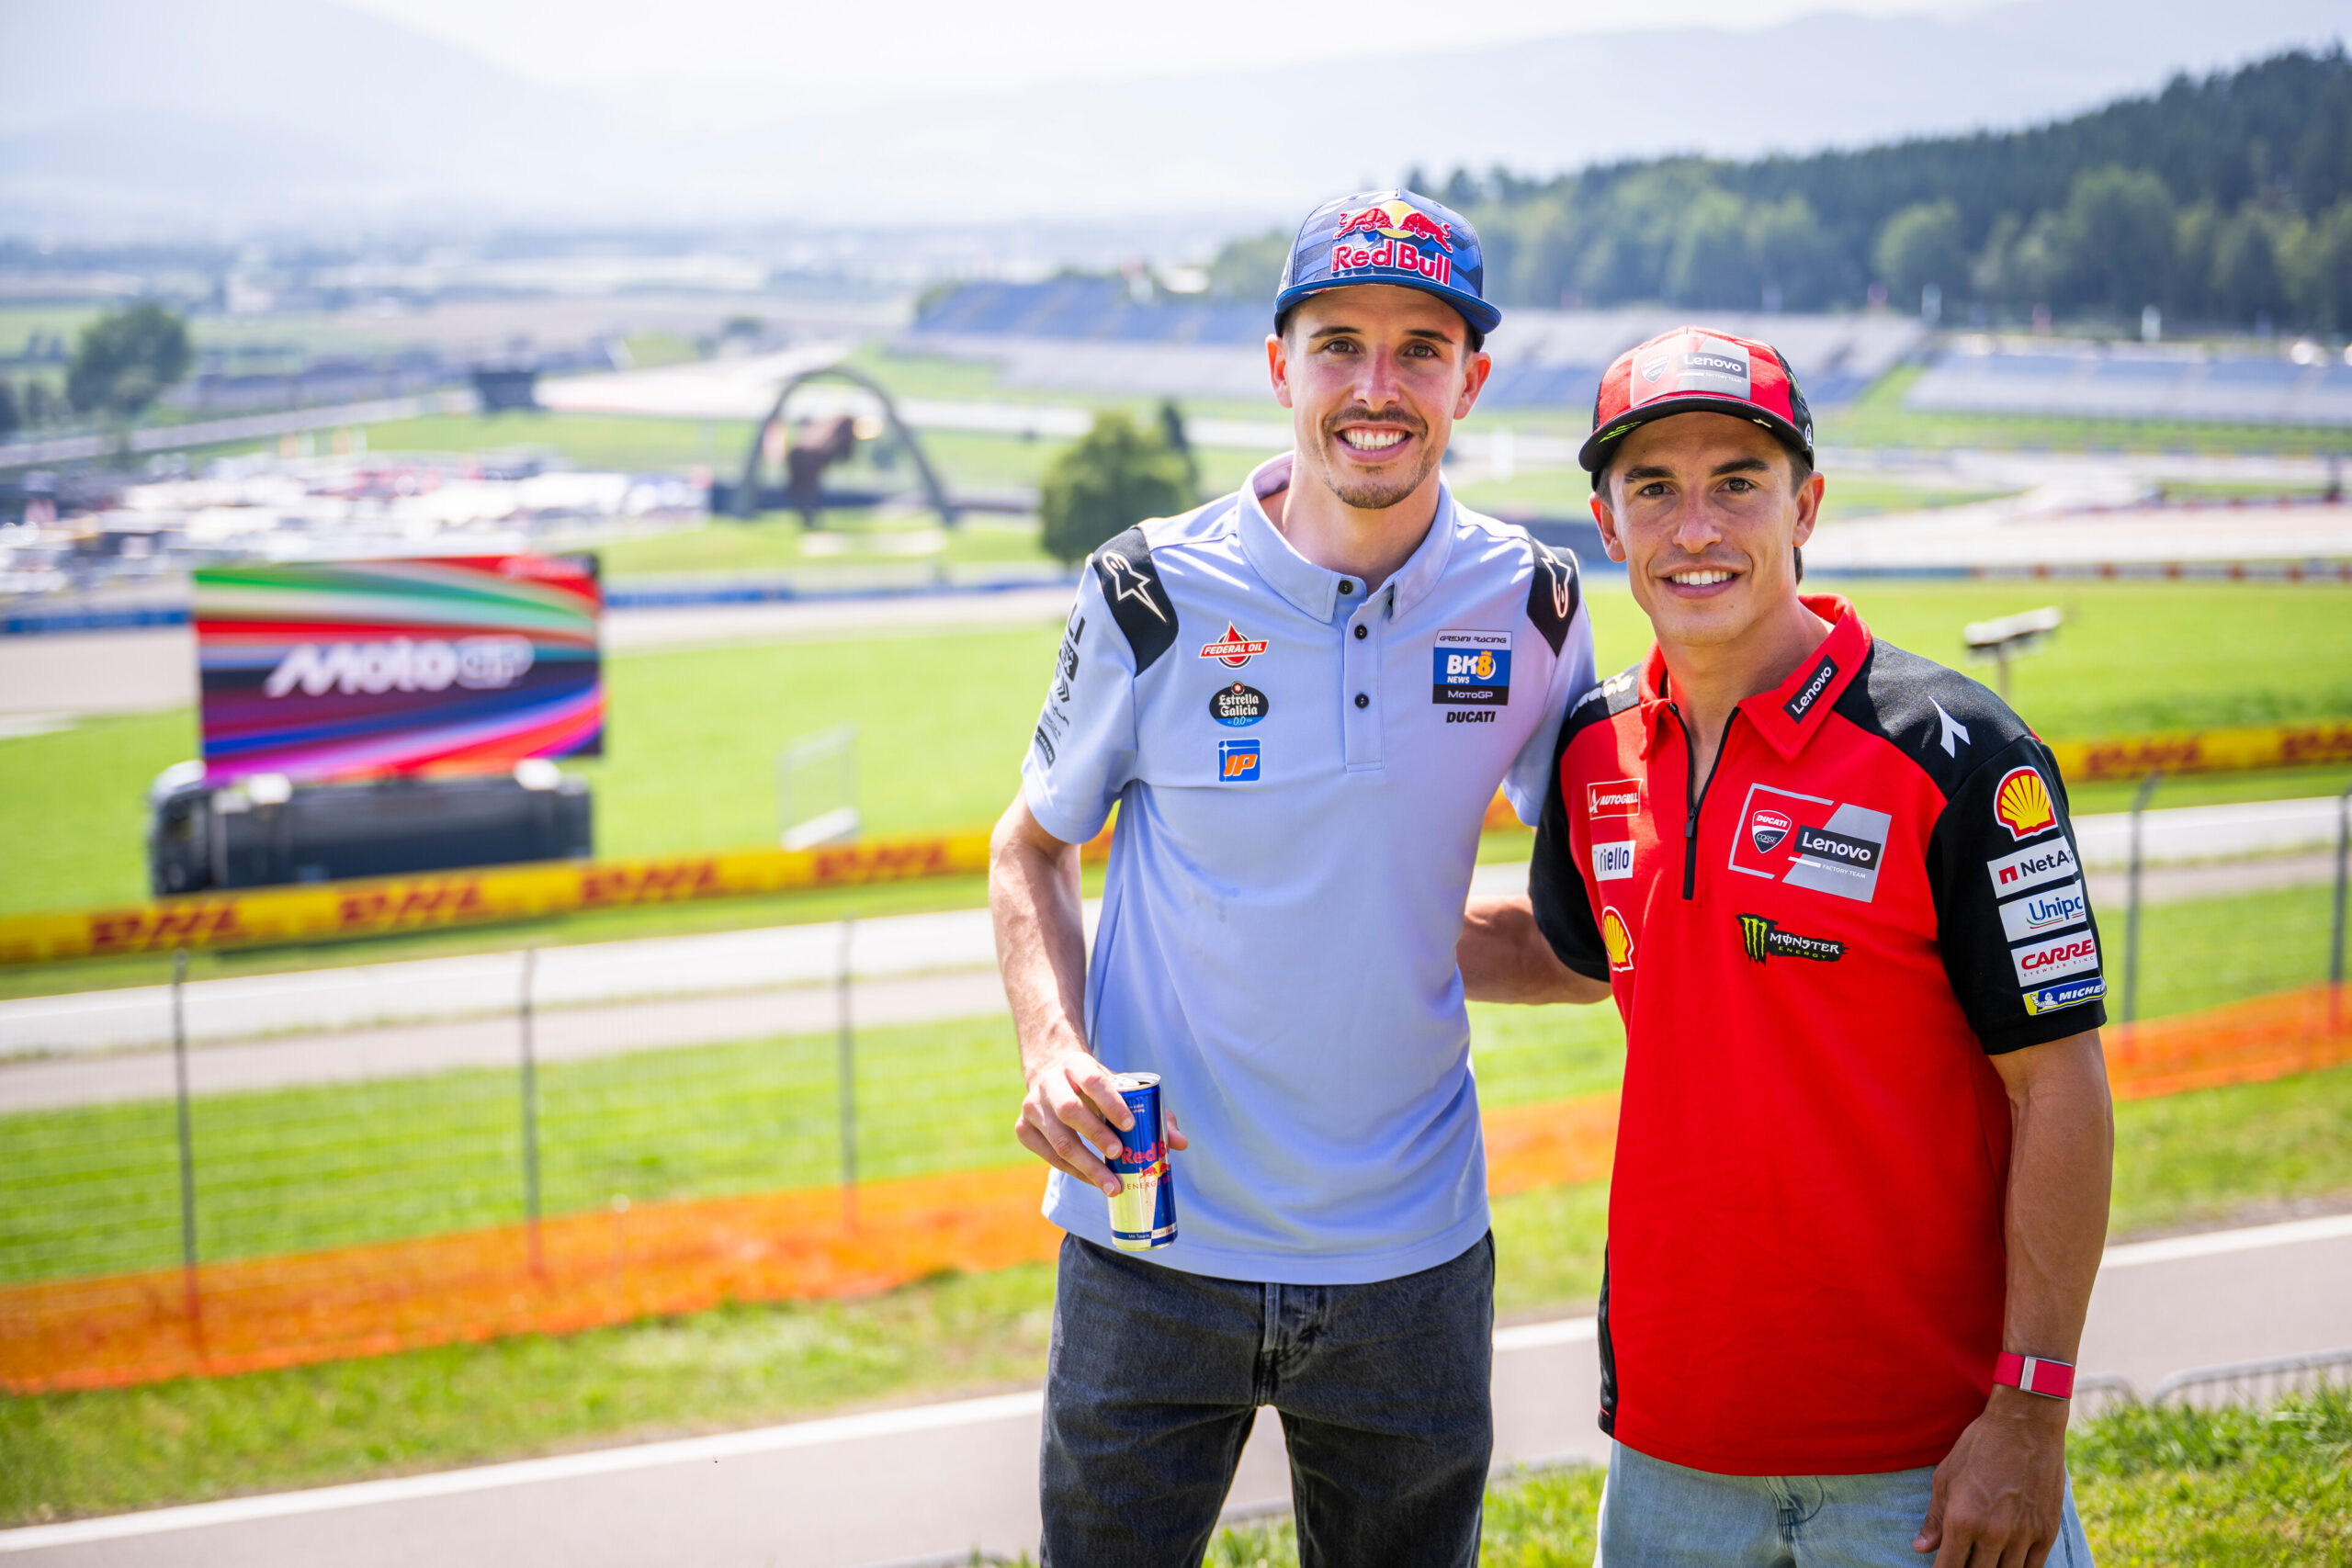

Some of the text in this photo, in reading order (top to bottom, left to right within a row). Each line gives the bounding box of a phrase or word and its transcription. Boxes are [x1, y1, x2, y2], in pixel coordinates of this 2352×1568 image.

[1332, 240, 1451, 286] Red Bull
[1684, 355, 1742, 372] Lenovo
[1204, 643, 1262, 655] FEDERAL OIL
[1447, 653, 1493, 677] BK8
[1792, 666, 1832, 715] Lenovo
[1218, 694, 1259, 705] Estrella
[1220, 705, 1258, 716] Galicia
[1446, 711, 1496, 723] DUCATI
[1223, 754, 1258, 776] IP
[1600, 792, 1638, 807] AUTOGRILL
[1757, 815, 1788, 828] DUCATI
[1757, 833, 1778, 843] CORSE
[1802, 831, 1871, 861] Lenovo
[1600, 847, 1630, 872] riello
[1822, 864, 1866, 879] FACTORY TEAM
[1779, 946, 1827, 959] ENERGY
[2021, 939, 2095, 970] CARRE
[2023, 956, 2095, 977] EYEWEAR SINC
[1122, 1142, 1157, 1165] Red
